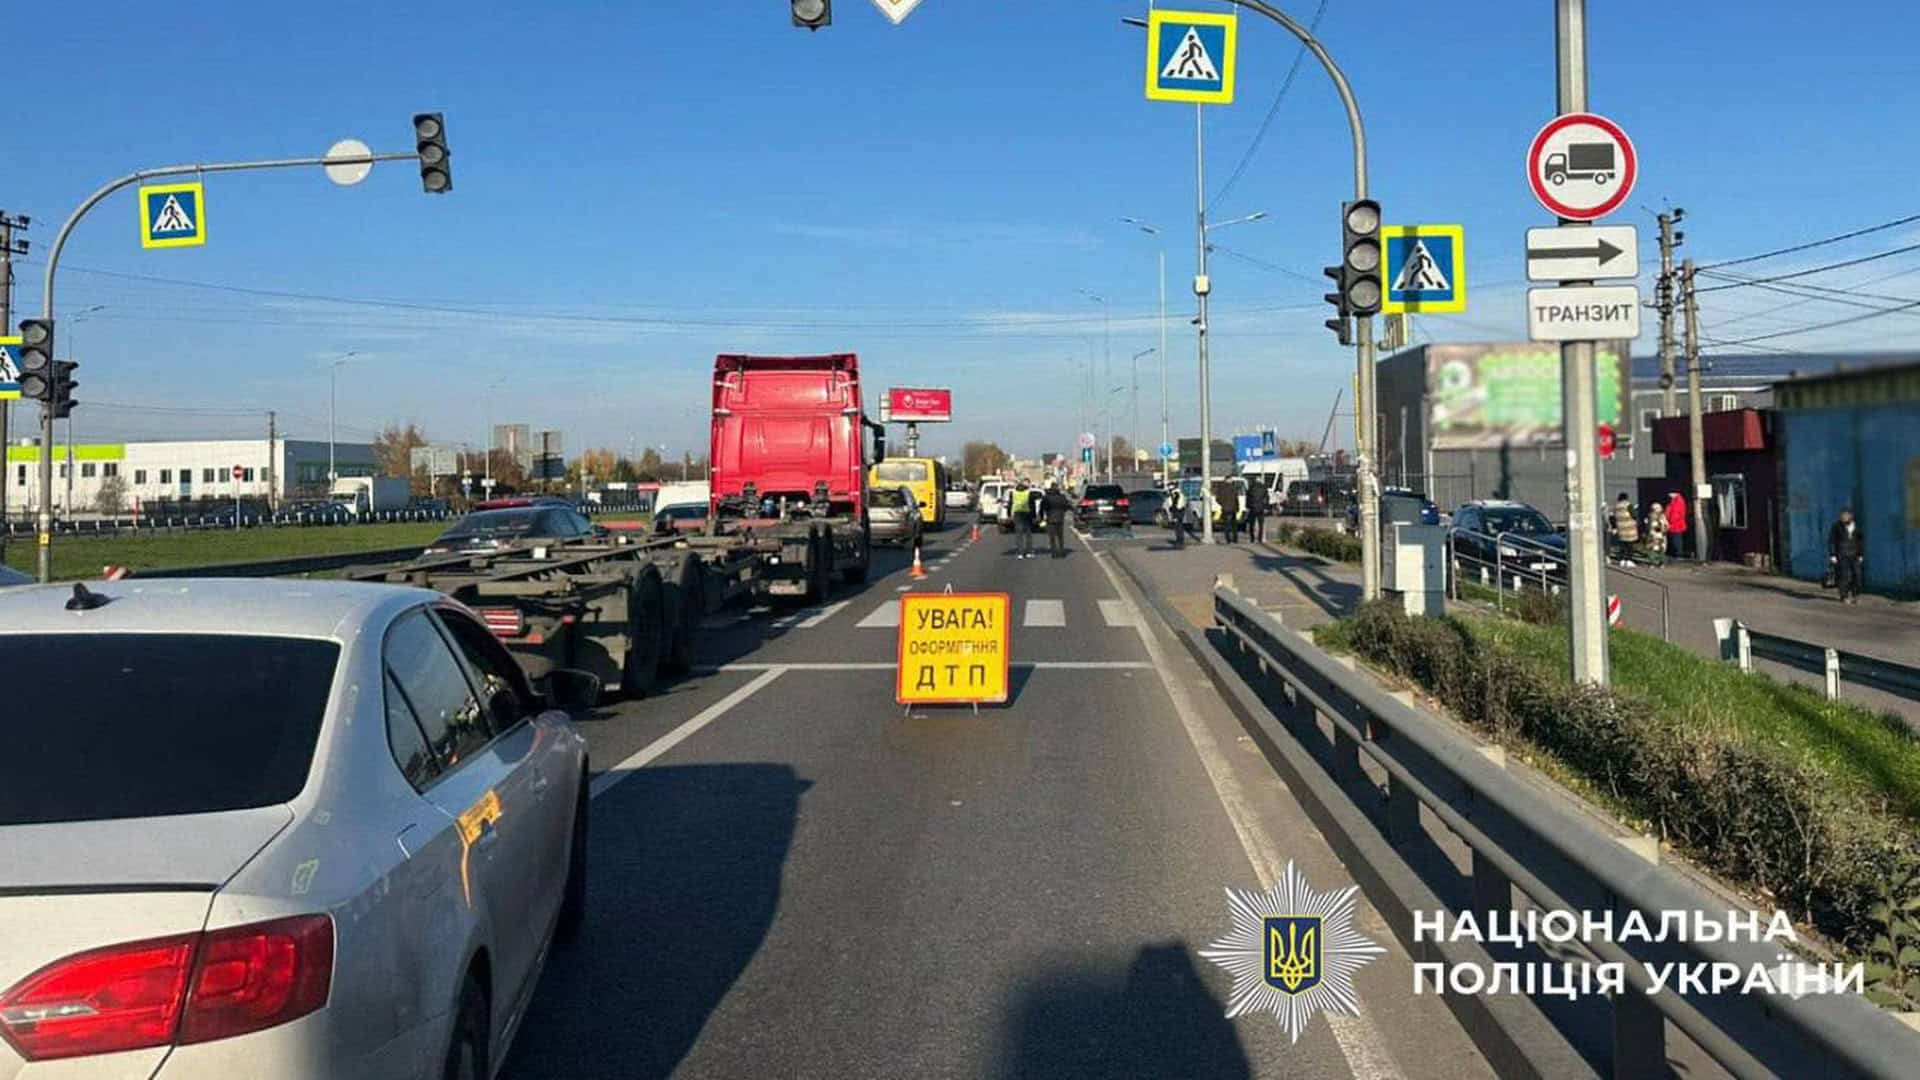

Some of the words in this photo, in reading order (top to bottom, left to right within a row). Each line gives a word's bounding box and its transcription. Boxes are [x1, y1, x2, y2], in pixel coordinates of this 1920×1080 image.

[1535, 304, 1633, 323] ТРАНЗИТ
[917, 608, 993, 629] УВАГА!
[910, 640, 998, 655] ОФОРМЛЕННЯ
